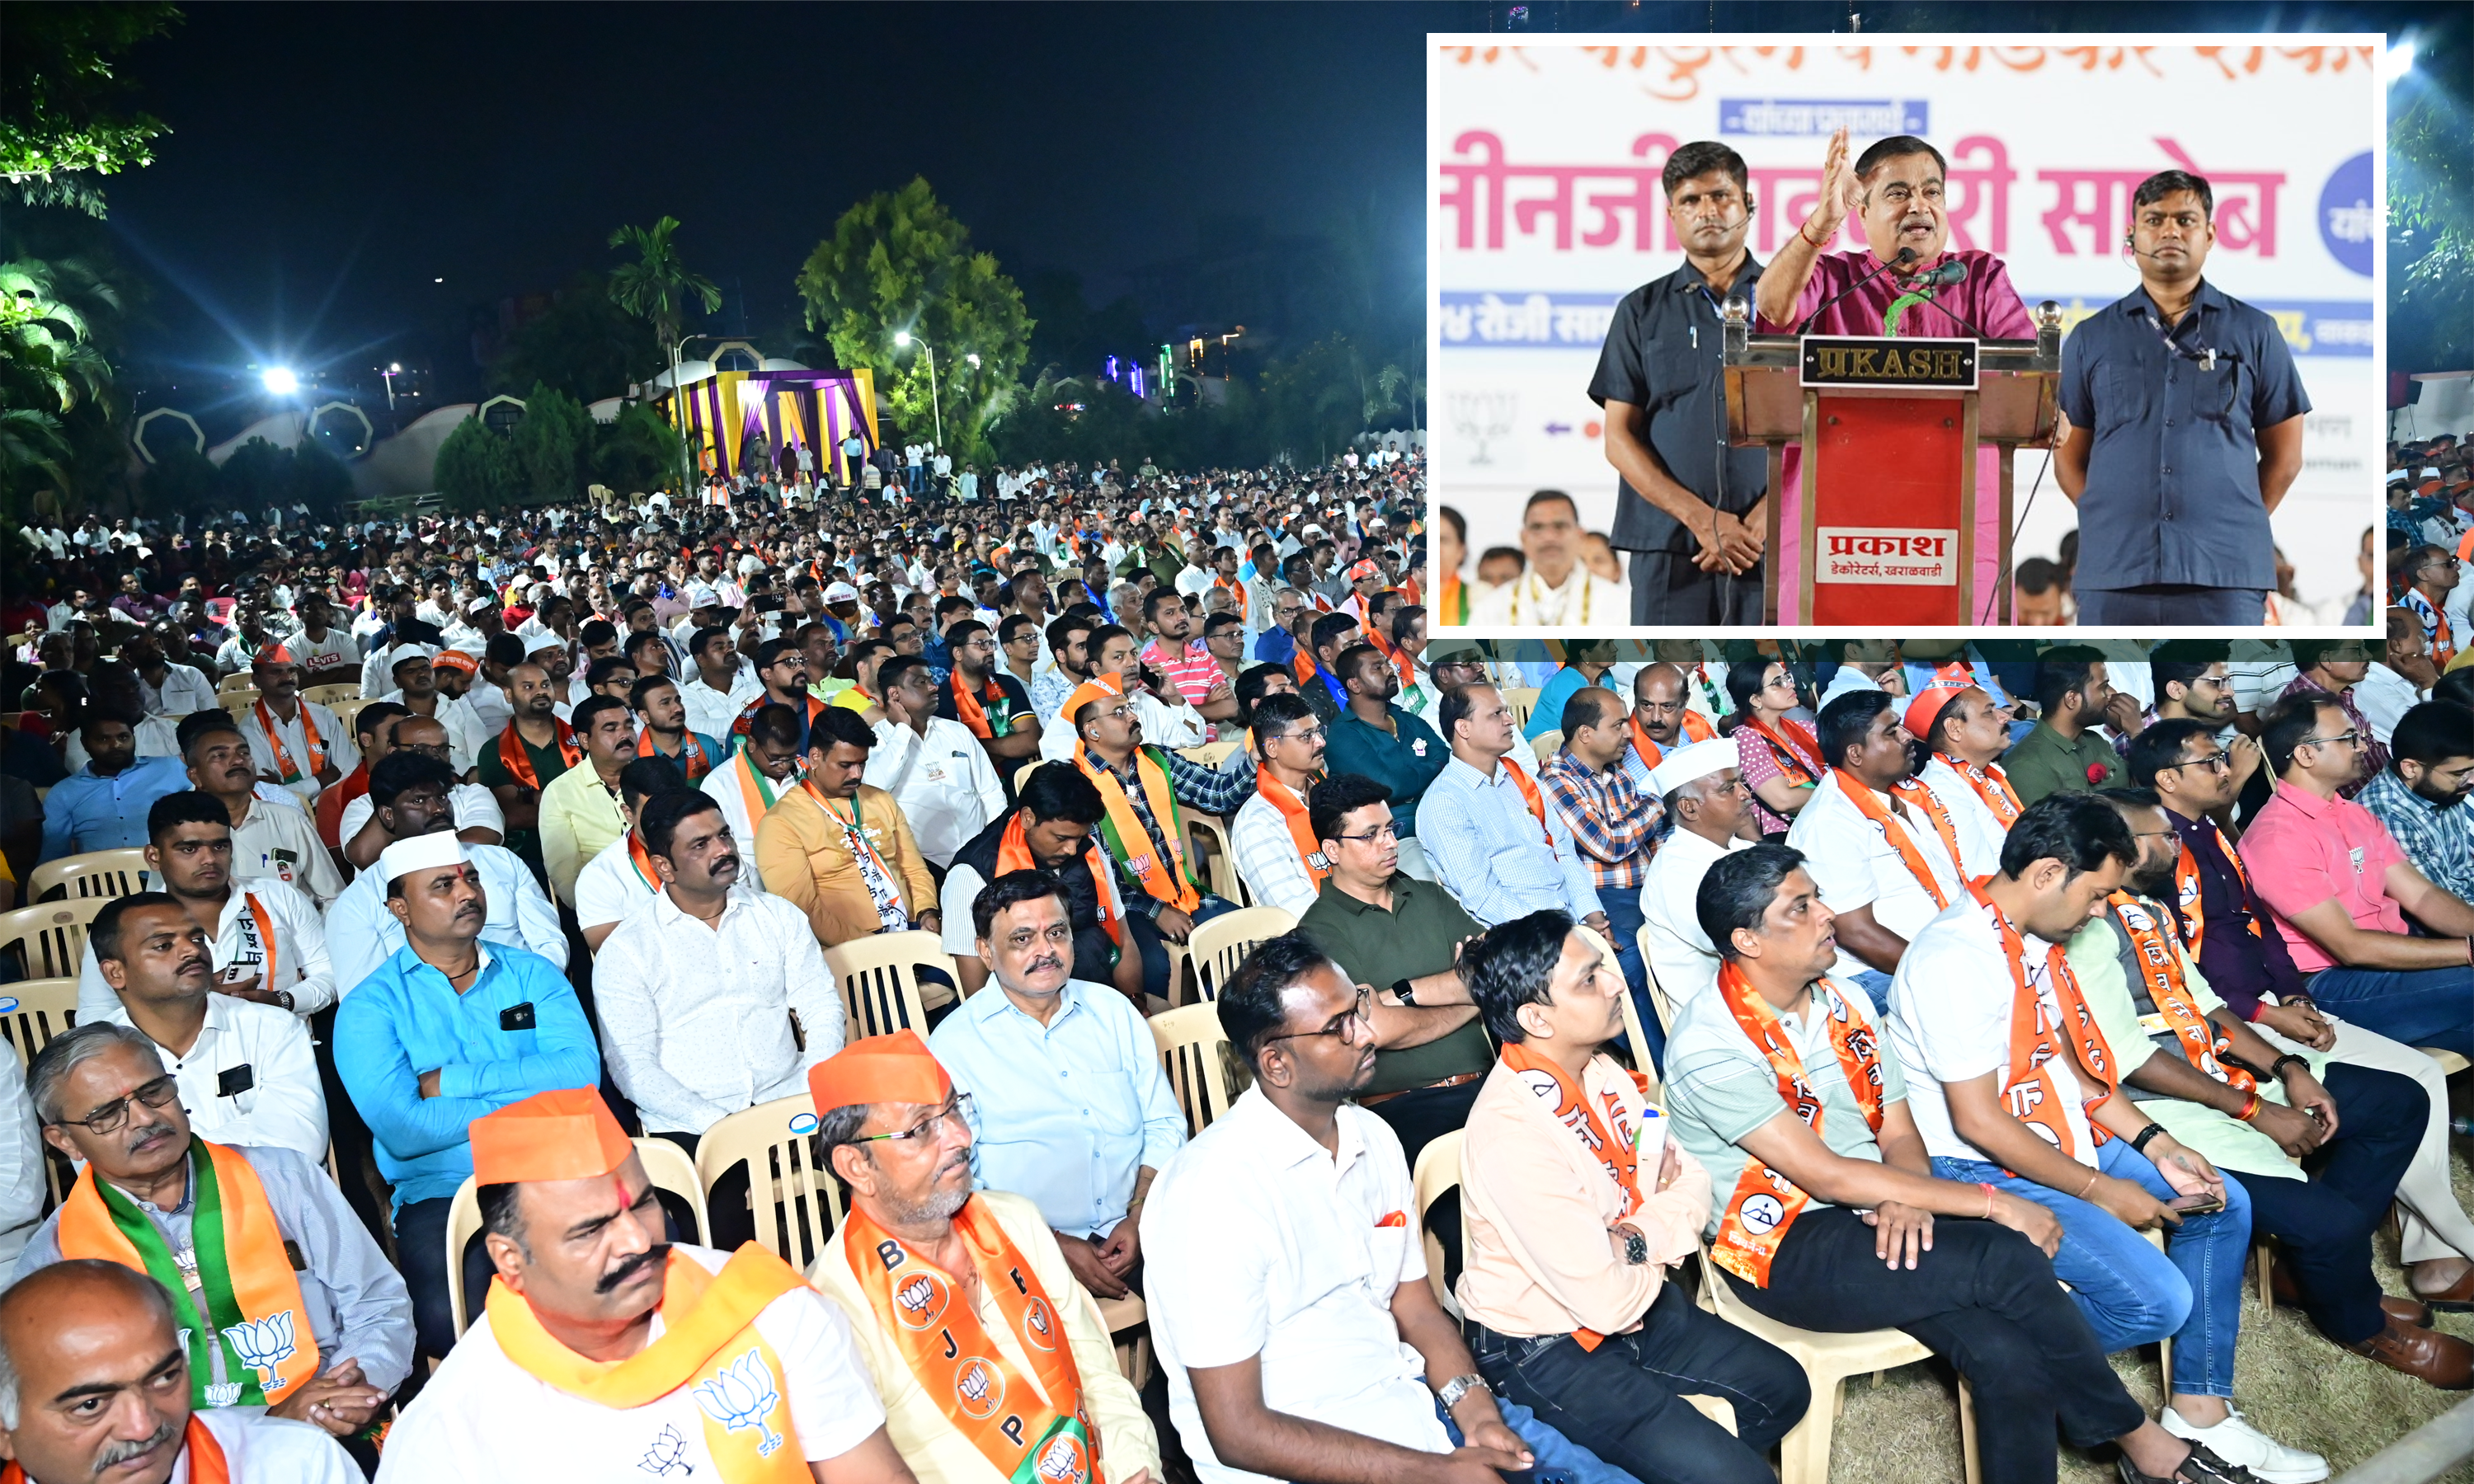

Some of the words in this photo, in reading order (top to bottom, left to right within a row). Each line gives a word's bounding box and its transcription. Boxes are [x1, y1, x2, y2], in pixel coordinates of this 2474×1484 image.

[2037, 136, 2286, 258] साेब
[1827, 536, 1947, 556] प्रकाश
[1831, 561, 1882, 577] डेकोरेटर्स,
[1884, 563, 1942, 577] खराळवाडी
[308, 654, 338, 666] LEVI'S
